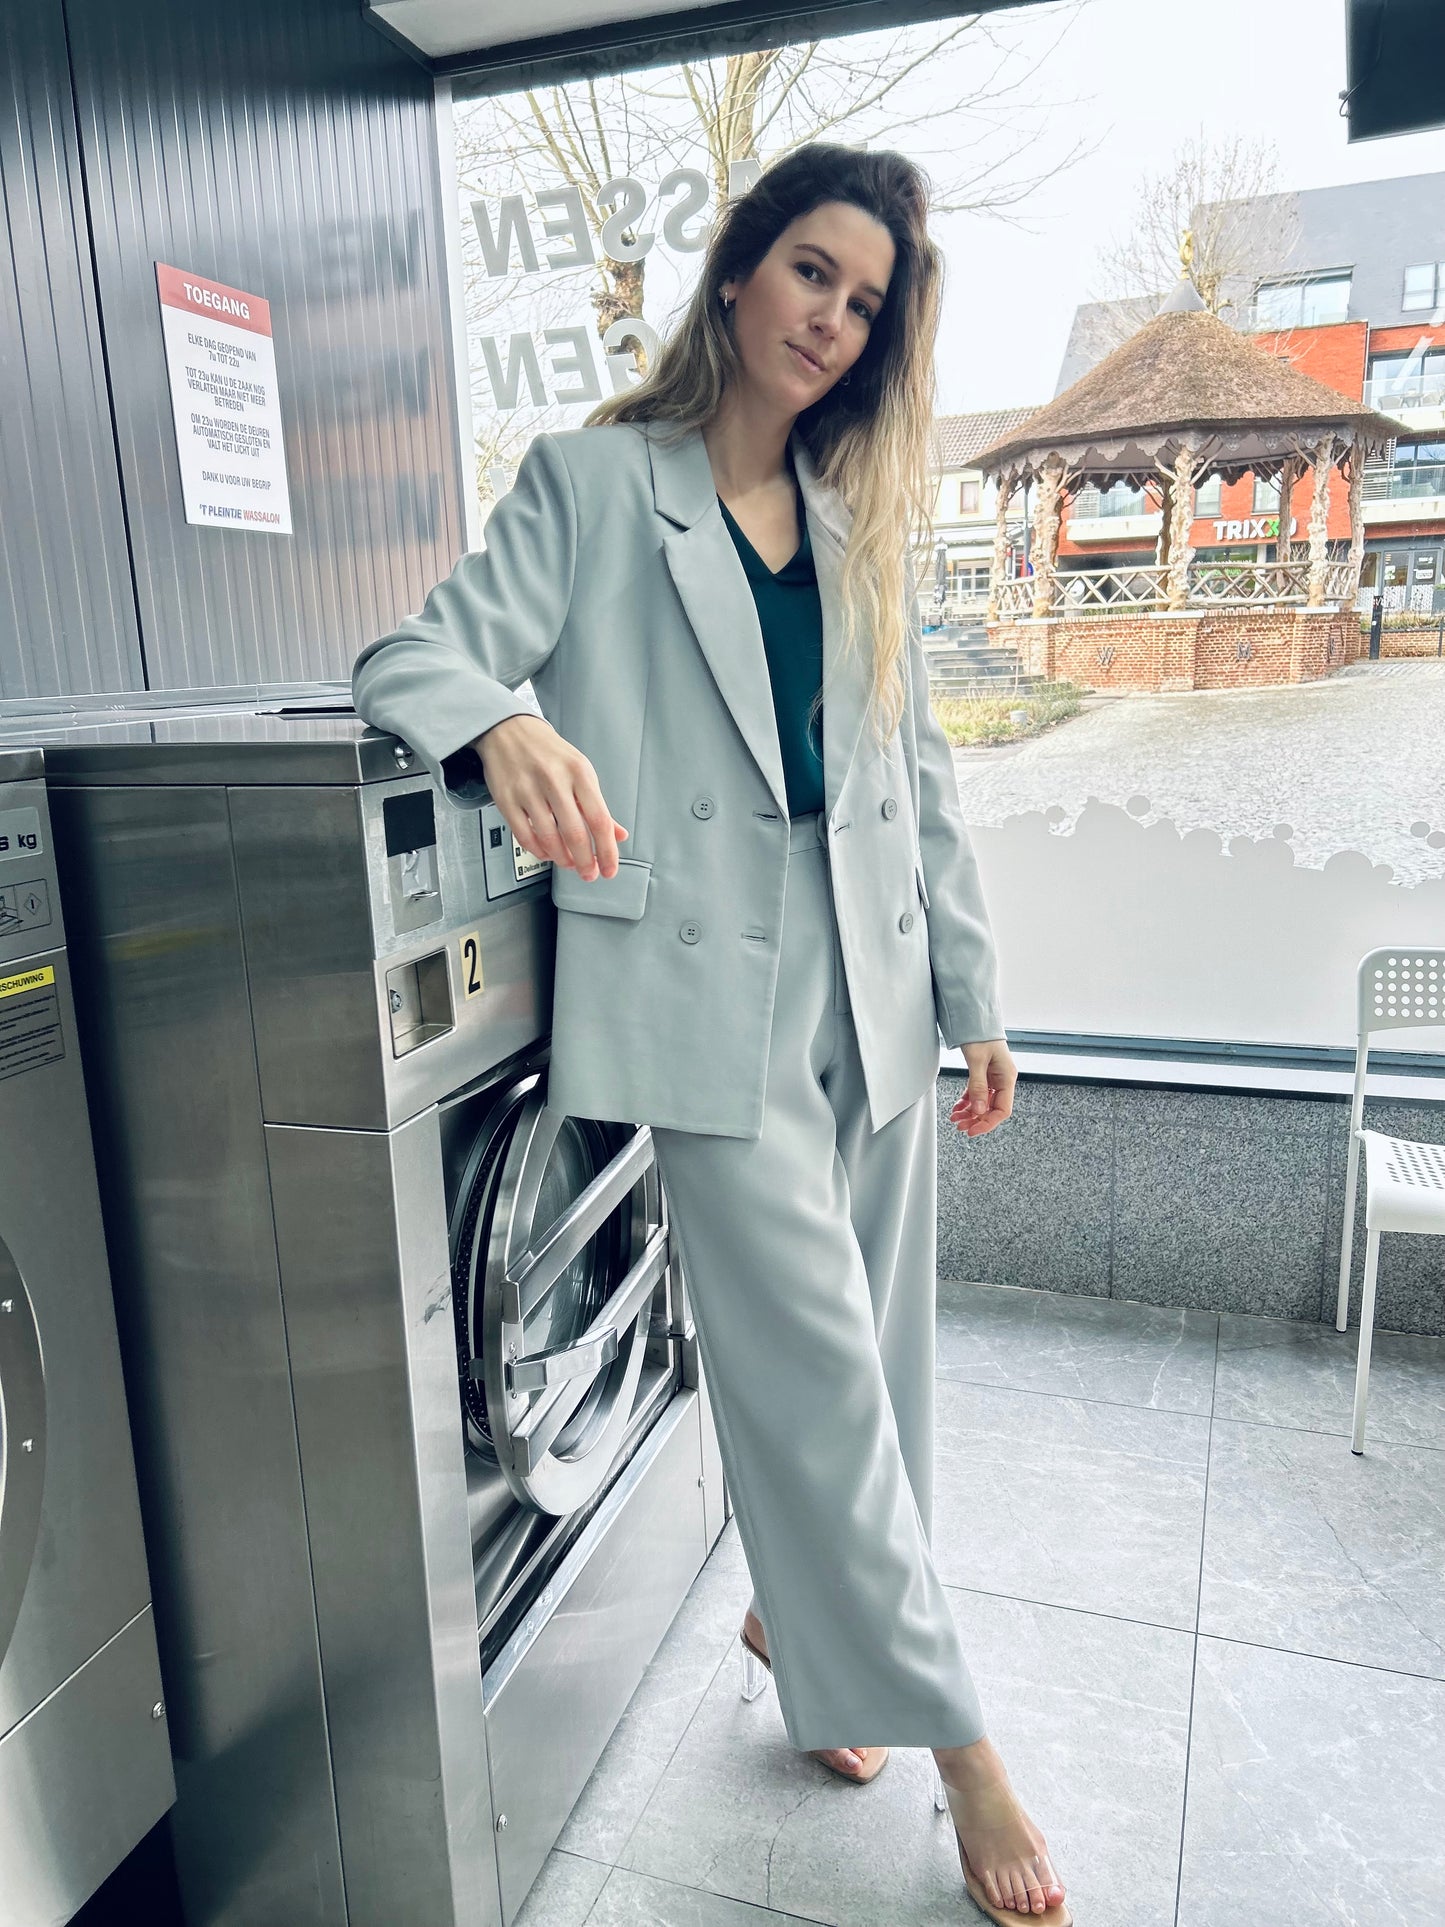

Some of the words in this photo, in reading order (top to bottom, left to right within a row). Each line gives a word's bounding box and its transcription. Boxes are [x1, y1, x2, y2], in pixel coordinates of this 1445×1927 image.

[183, 282, 250, 320] TOEGANG
[188, 332, 203, 347] ELKE
[204, 338, 217, 351] DAG
[217, 341, 245, 358] GEOPEND
[245, 349, 257, 362] VAN
[217, 352, 228, 364] TOT
[229, 356, 240, 368] 22u
[185, 366, 197, 378] TOT
[198, 369, 209, 381] 23u
[210, 372, 223, 385] KAN
[223, 376, 229, 386] U
[229, 377, 237, 389] DE
[238, 380, 253, 393] ZAAK
[253, 384, 266, 396] NOG
[187, 378, 219, 395] VERLATEN
[219, 386, 237, 399] MAAR
[237, 390, 249, 403] NIET
[250, 393, 266, 407] MEER
[214, 396, 245, 412] BETREDEN
[190, 413, 201, 424] OM
[202, 415, 213, 427] 23u
[213, 417, 239, 433] WORDEN
[240, 423, 248, 434] DE
[248, 424, 270, 439] DEUREN
[193, 424, 233, 441] AUTOMATISCH
[234, 433, 262, 448] GESLOTEN
[263, 438, 271, 449] EN
[206, 439, 221, 451] VALT
[222, 441, 233, 452] HET
[234, 443, 250, 456] LICHT
[250, 447, 260, 457] UIT
[202, 470, 219, 482] DANK
[219, 473, 224, 484] U
[224, 473, 240, 486] VOOR
[241, 476, 251, 488] UW
[252, 478, 271, 491] BEGRIP
[208, 505, 242, 520] PLEINTJE
[243, 509, 280, 524] WASSALON
[18, 833, 37, 850] kg
[464, 938, 481, 993] 2
[0, 973, 44, 993] SCHUWING
